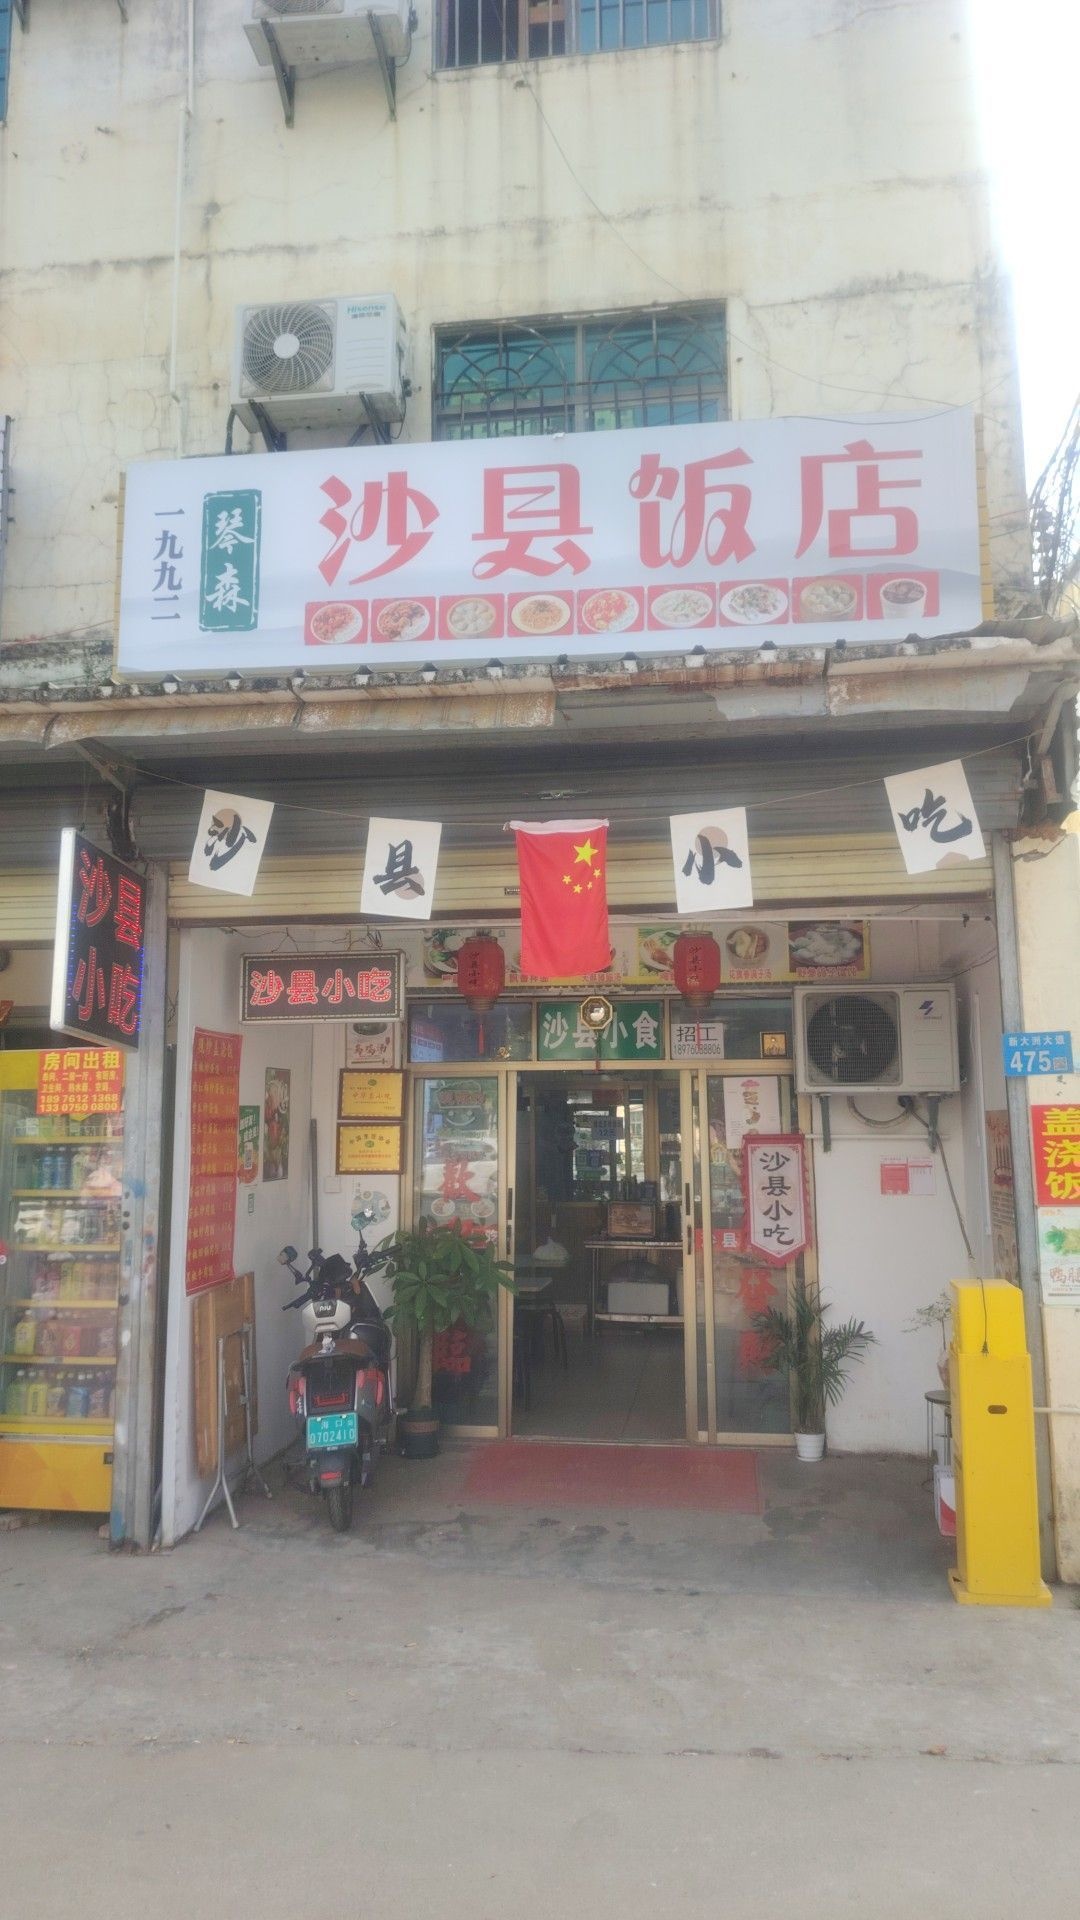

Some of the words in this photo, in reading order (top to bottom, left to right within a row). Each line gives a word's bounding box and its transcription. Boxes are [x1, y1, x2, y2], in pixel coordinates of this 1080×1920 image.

[317, 440, 923, 586] 沙县饭店
[150, 508, 185, 621] 一九九二
[205, 507, 256, 613] 琴森
[204, 813, 257, 872] 沙
[372, 839, 425, 896] 县
[682, 834, 743, 885] 小
[897, 788, 973, 843] 吃
[250, 967, 393, 1007] 沙县小吃
[542, 1010, 659, 1049] 沙县小食
[675, 1025, 718, 1043] 招工
[1008, 1034, 1065, 1047] 新大洲大道
[43, 1051, 120, 1071] 房间出租
[1010, 1050, 1052, 1073] 475
[39, 1103, 59, 1113] 133
[61, 1103, 89, 1113] 0750
[91, 1102, 118, 1112] 0800
[40, 1094, 60, 1104] 189
[62, 1094, 89, 1104] 7612
[91, 1093, 118, 1103] 1368
[1042, 1107, 1080, 1200] 盖浇饭
[759, 1152, 794, 1246] 沙县小吃
[309, 1428, 355, 1445] 0702410
